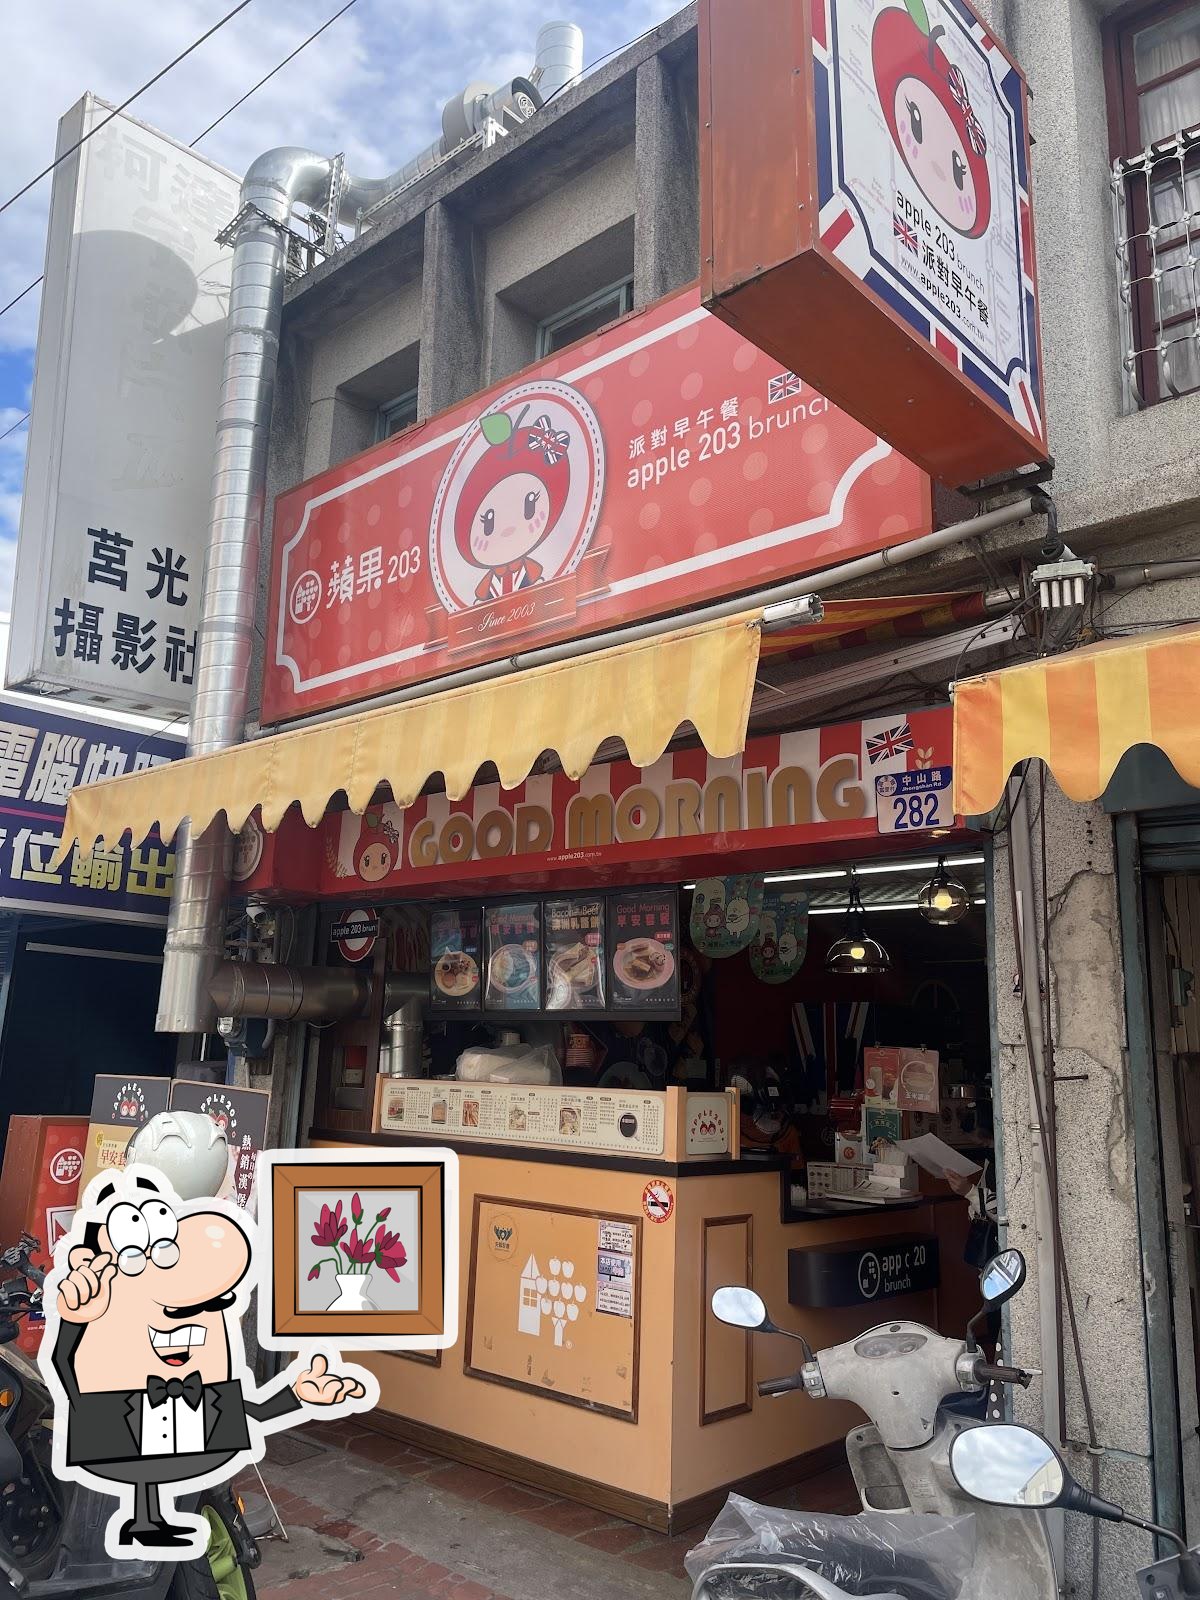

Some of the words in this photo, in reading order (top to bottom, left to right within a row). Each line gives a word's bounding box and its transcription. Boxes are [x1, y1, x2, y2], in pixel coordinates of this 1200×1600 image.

[897, 190, 932, 237] apple
[935, 225, 956, 263] 203
[956, 254, 986, 295] brunch
[921, 240, 990, 329] 派對早午餐
[627, 446, 691, 490] apple
[698, 421, 741, 462] 203
[628, 396, 739, 460] 派對早午餐
[87, 527, 189, 607] 莒光
[325, 546, 384, 609] 蘋果
[387, 545, 421, 585] 203
[53, 597, 198, 685] 攝影社
[477, 610, 507, 633] Since
[507, 601, 536, 623] 2003
[903, 771, 941, 786] 中山路
[411, 803, 554, 868] GOOD
[567, 754, 863, 850] MORNING
[893, 793, 939, 829] 282
[0, 827, 176, 897] 位輸出
[333, 927, 350, 938] apple
[350, 923, 362, 935] 203
[551, 907, 573, 918] Bacon
[616, 904, 637, 914] Good
[639, 903, 670, 915] Morning
[884, 1274, 911, 1293] brunch
